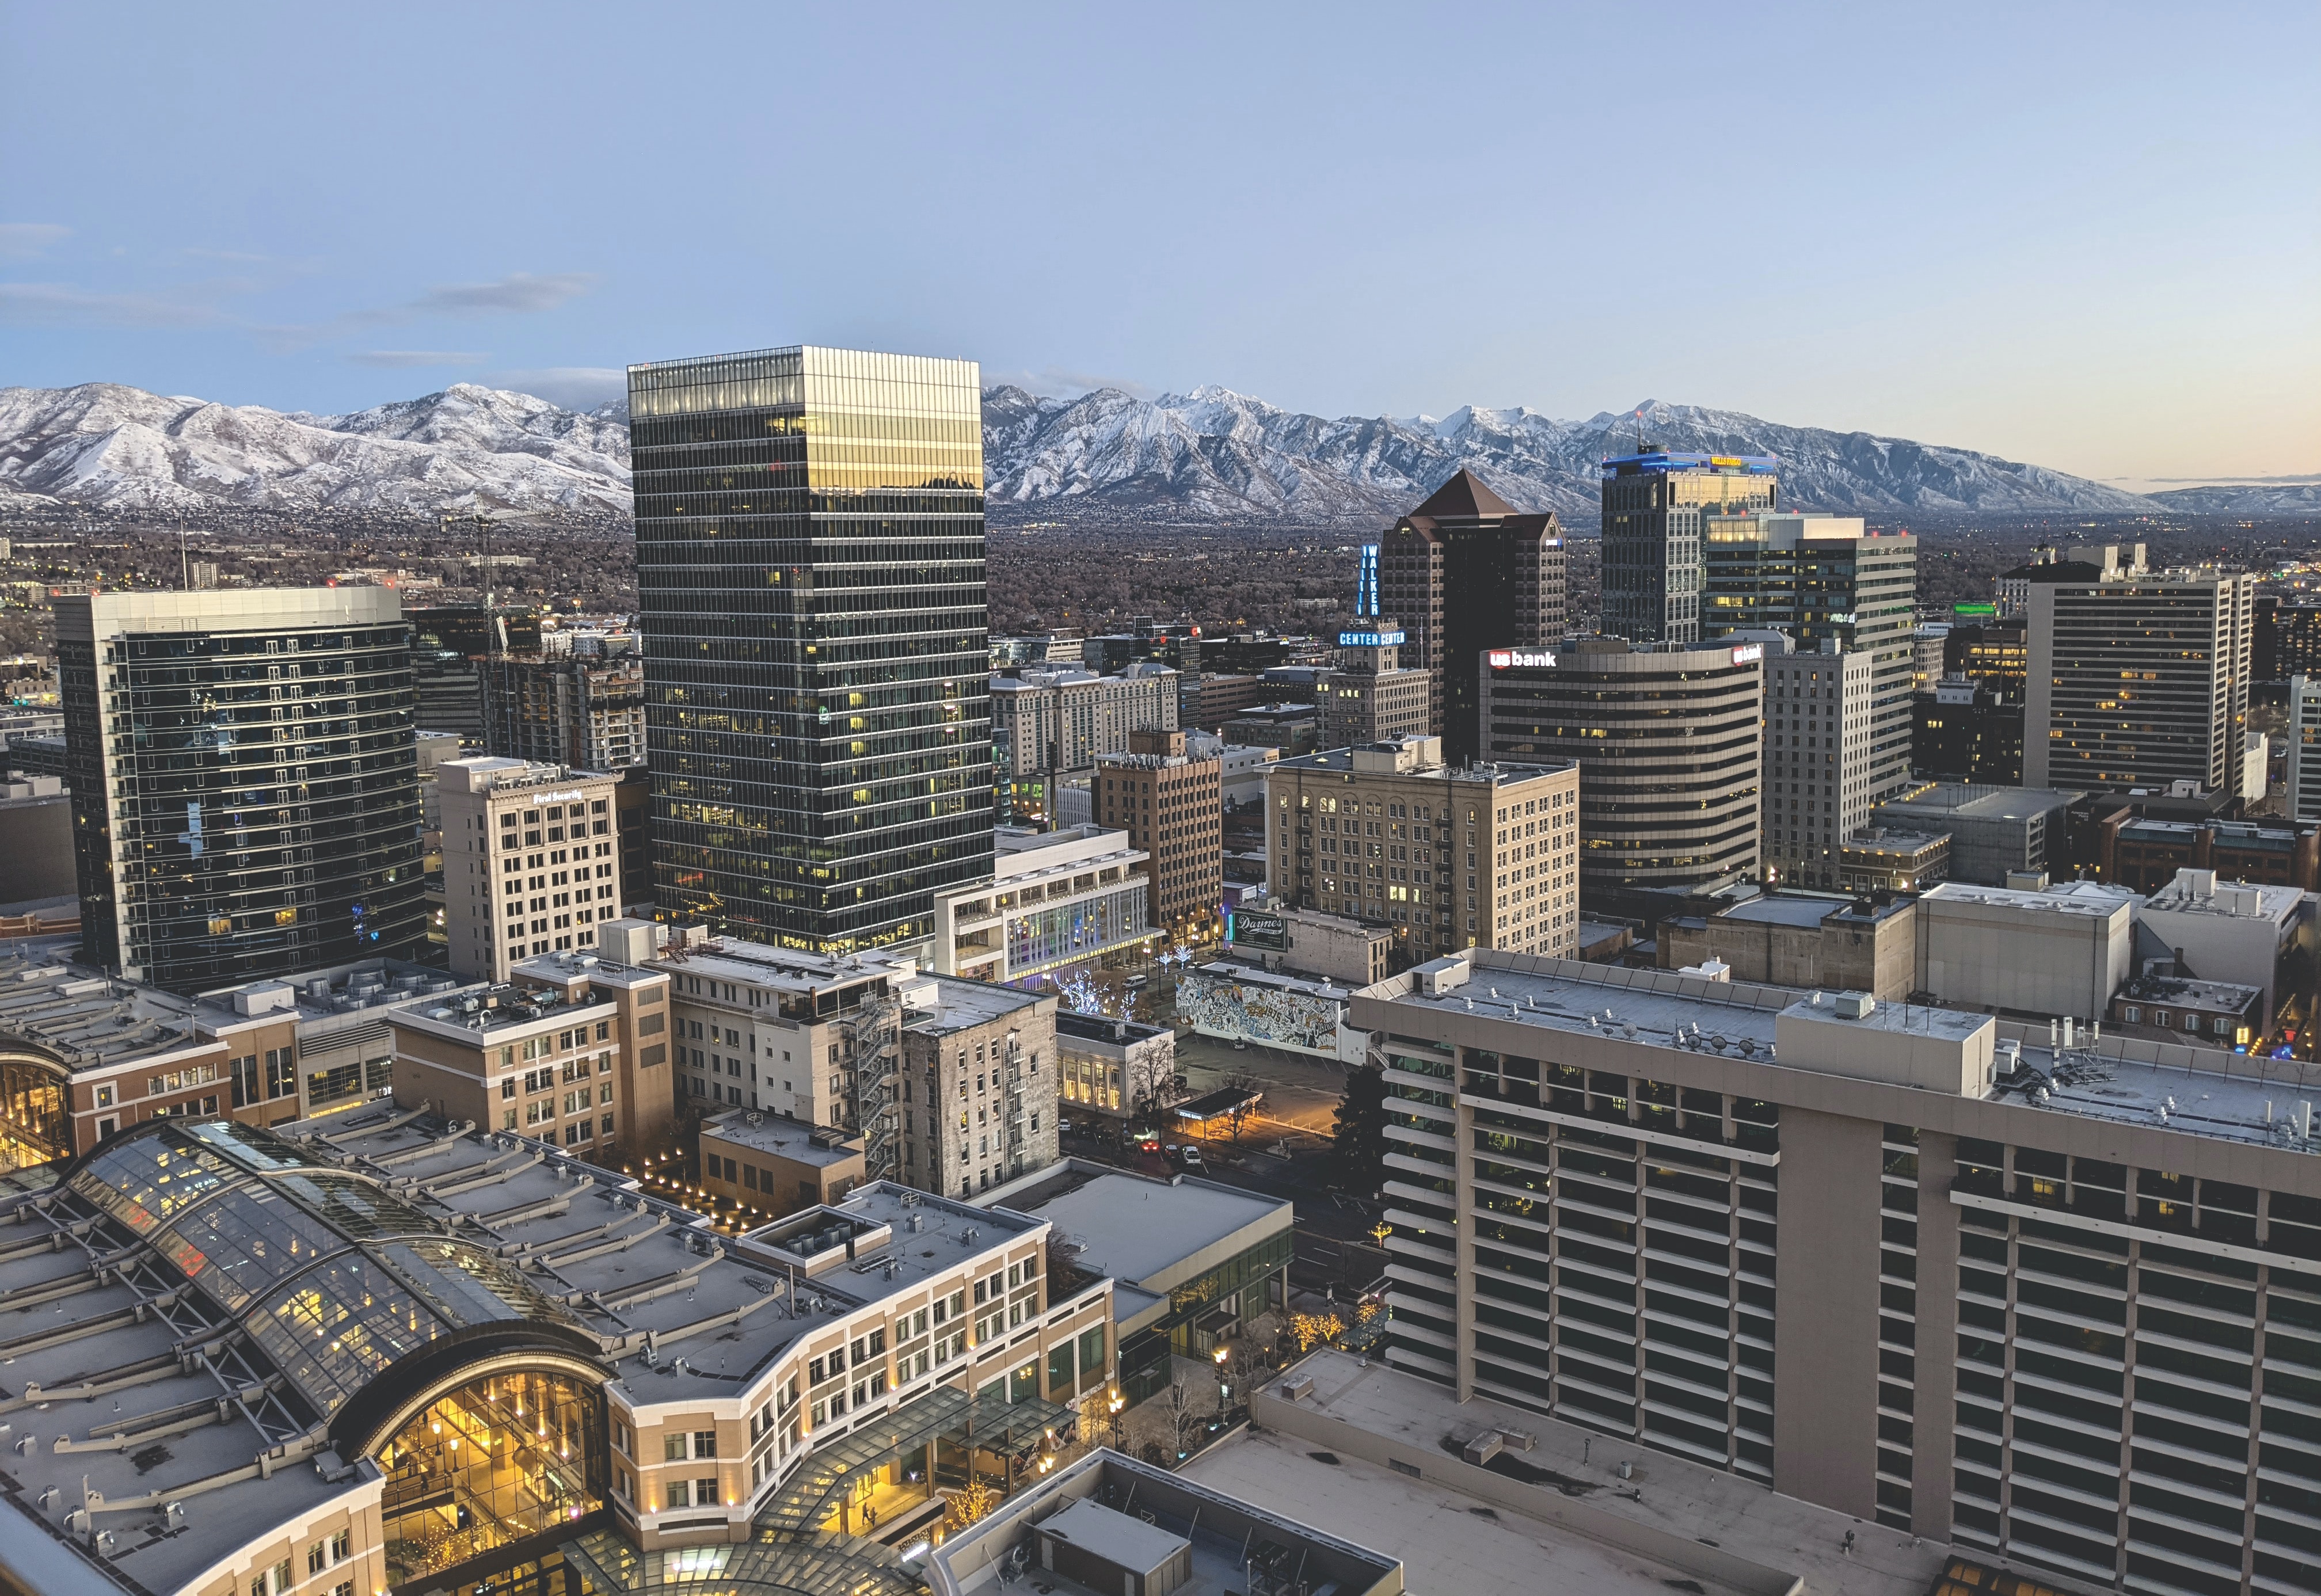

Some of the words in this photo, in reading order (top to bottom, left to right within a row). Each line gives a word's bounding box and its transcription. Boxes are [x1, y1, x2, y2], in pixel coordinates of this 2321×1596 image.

[1711, 456, 1726, 465] WELLS
[1726, 457, 1741, 466] FARGO
[1369, 546, 1378, 615] WALKER
[1340, 633, 1378, 645] CENTER
[1381, 632, 1405, 645] CENTER
[1512, 651, 1556, 666] bank
[533, 793, 551, 804] First
[553, 790, 581, 801] Security
[1237, 915, 1283, 932] Daynes
[1014, 967, 1038, 978] GEORGE
[1061, 953, 1087, 965] DOLORES
[1108, 941, 1128, 951] ECCLES
[1131, 934, 1154, 944] THEATER
